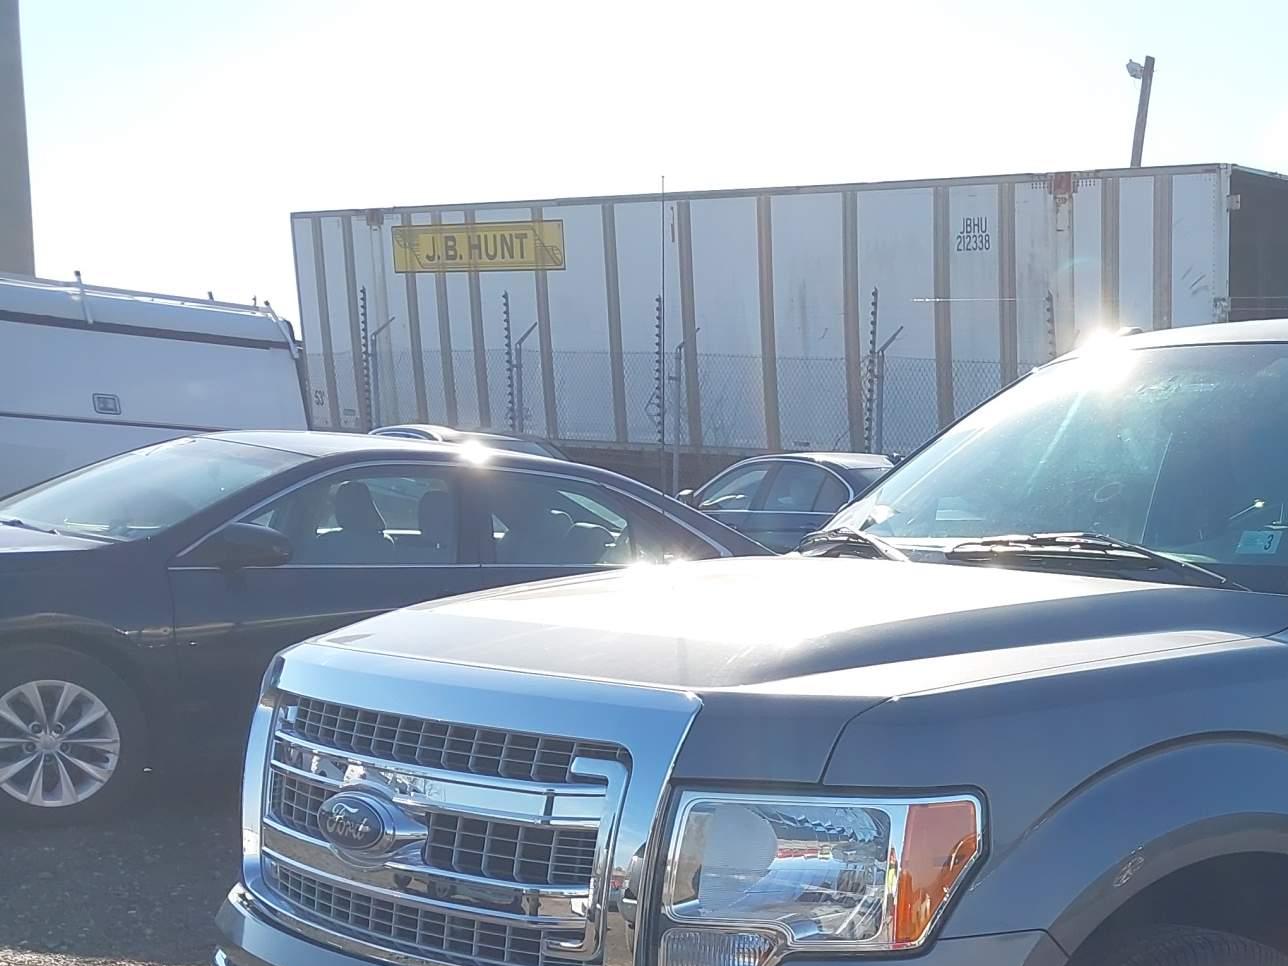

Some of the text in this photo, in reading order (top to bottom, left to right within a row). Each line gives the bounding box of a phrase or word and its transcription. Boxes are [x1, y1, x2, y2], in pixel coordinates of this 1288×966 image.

[959, 216, 988, 235] JBHU
[426, 232, 528, 262] J.B. HUNT
[956, 233, 991, 252] 212338
[1263, 533, 1274, 551] 3
[326, 802, 371, 841] Ford
